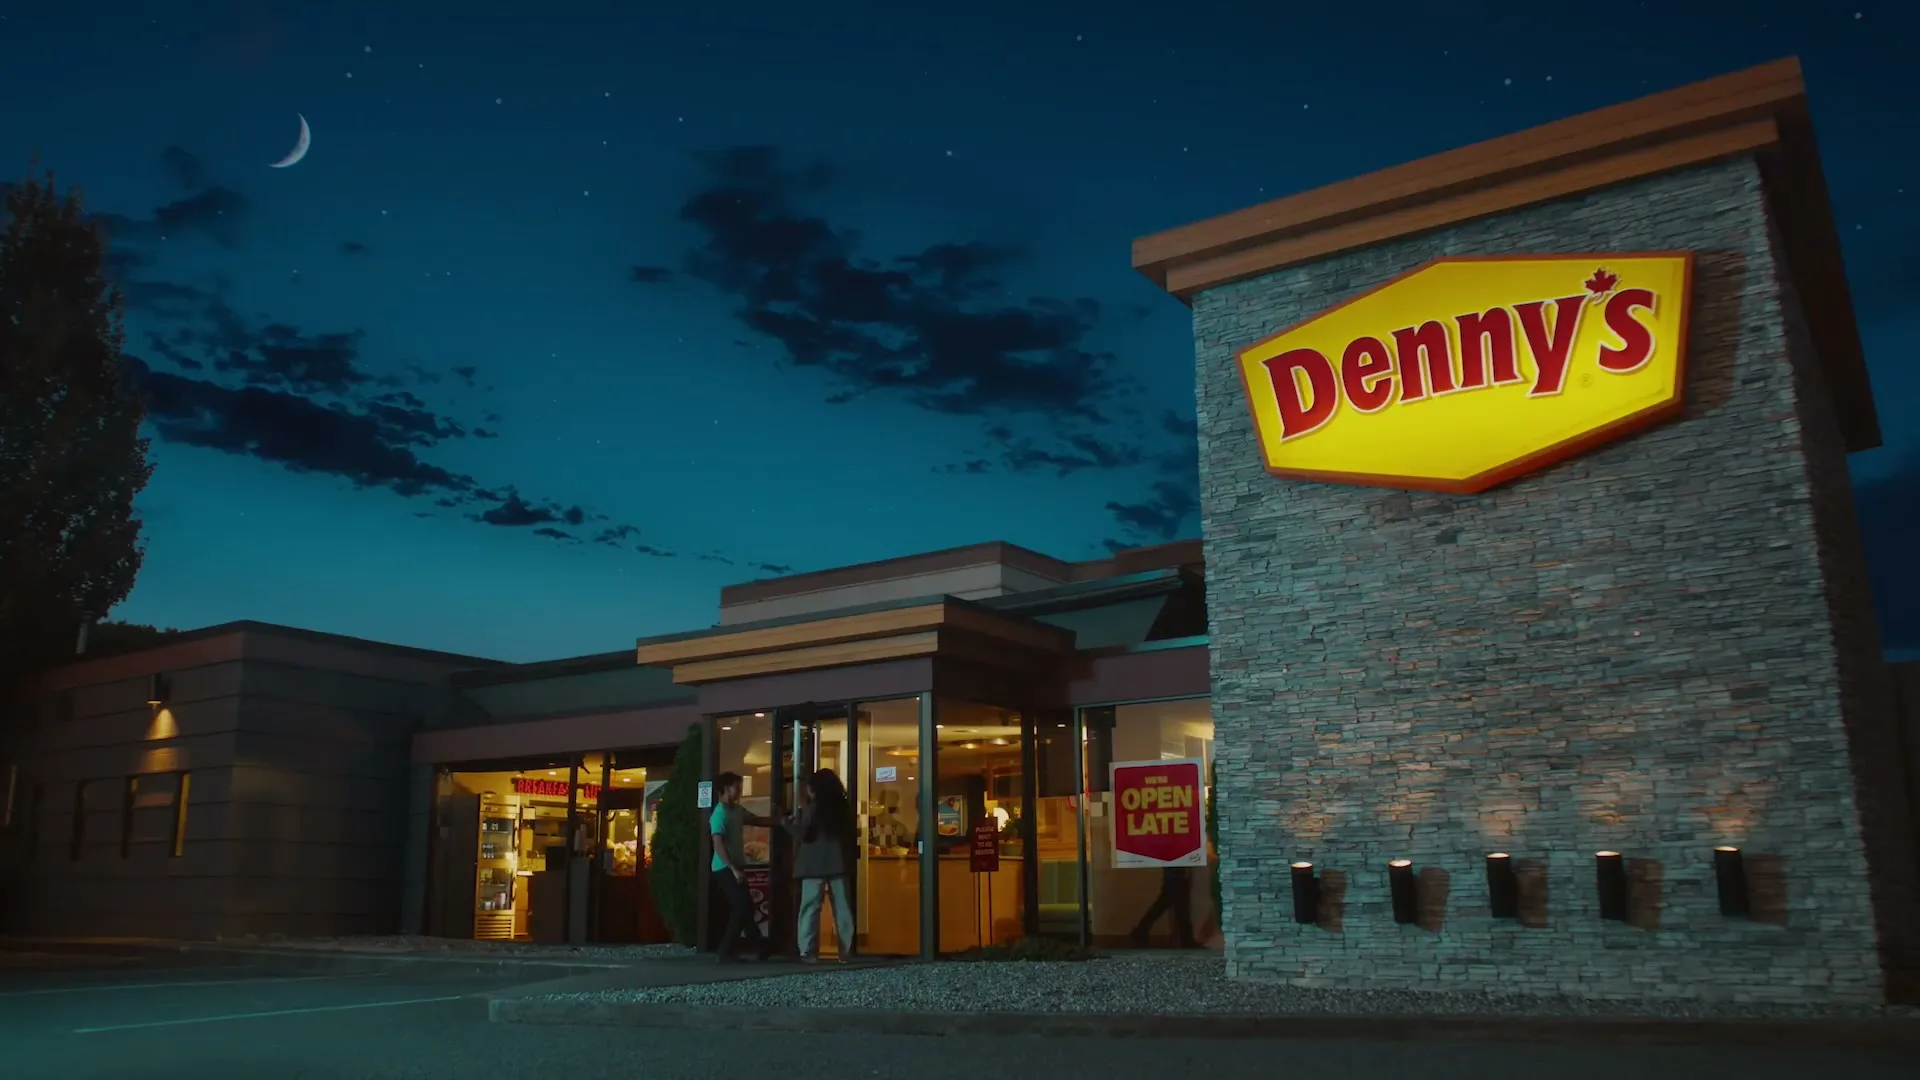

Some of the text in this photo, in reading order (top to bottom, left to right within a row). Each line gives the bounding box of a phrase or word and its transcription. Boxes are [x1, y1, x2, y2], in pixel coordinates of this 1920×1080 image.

[1262, 268, 1657, 443] Denny's
[1121, 785, 1192, 810] OPEN
[1127, 812, 1189, 836] LATE
